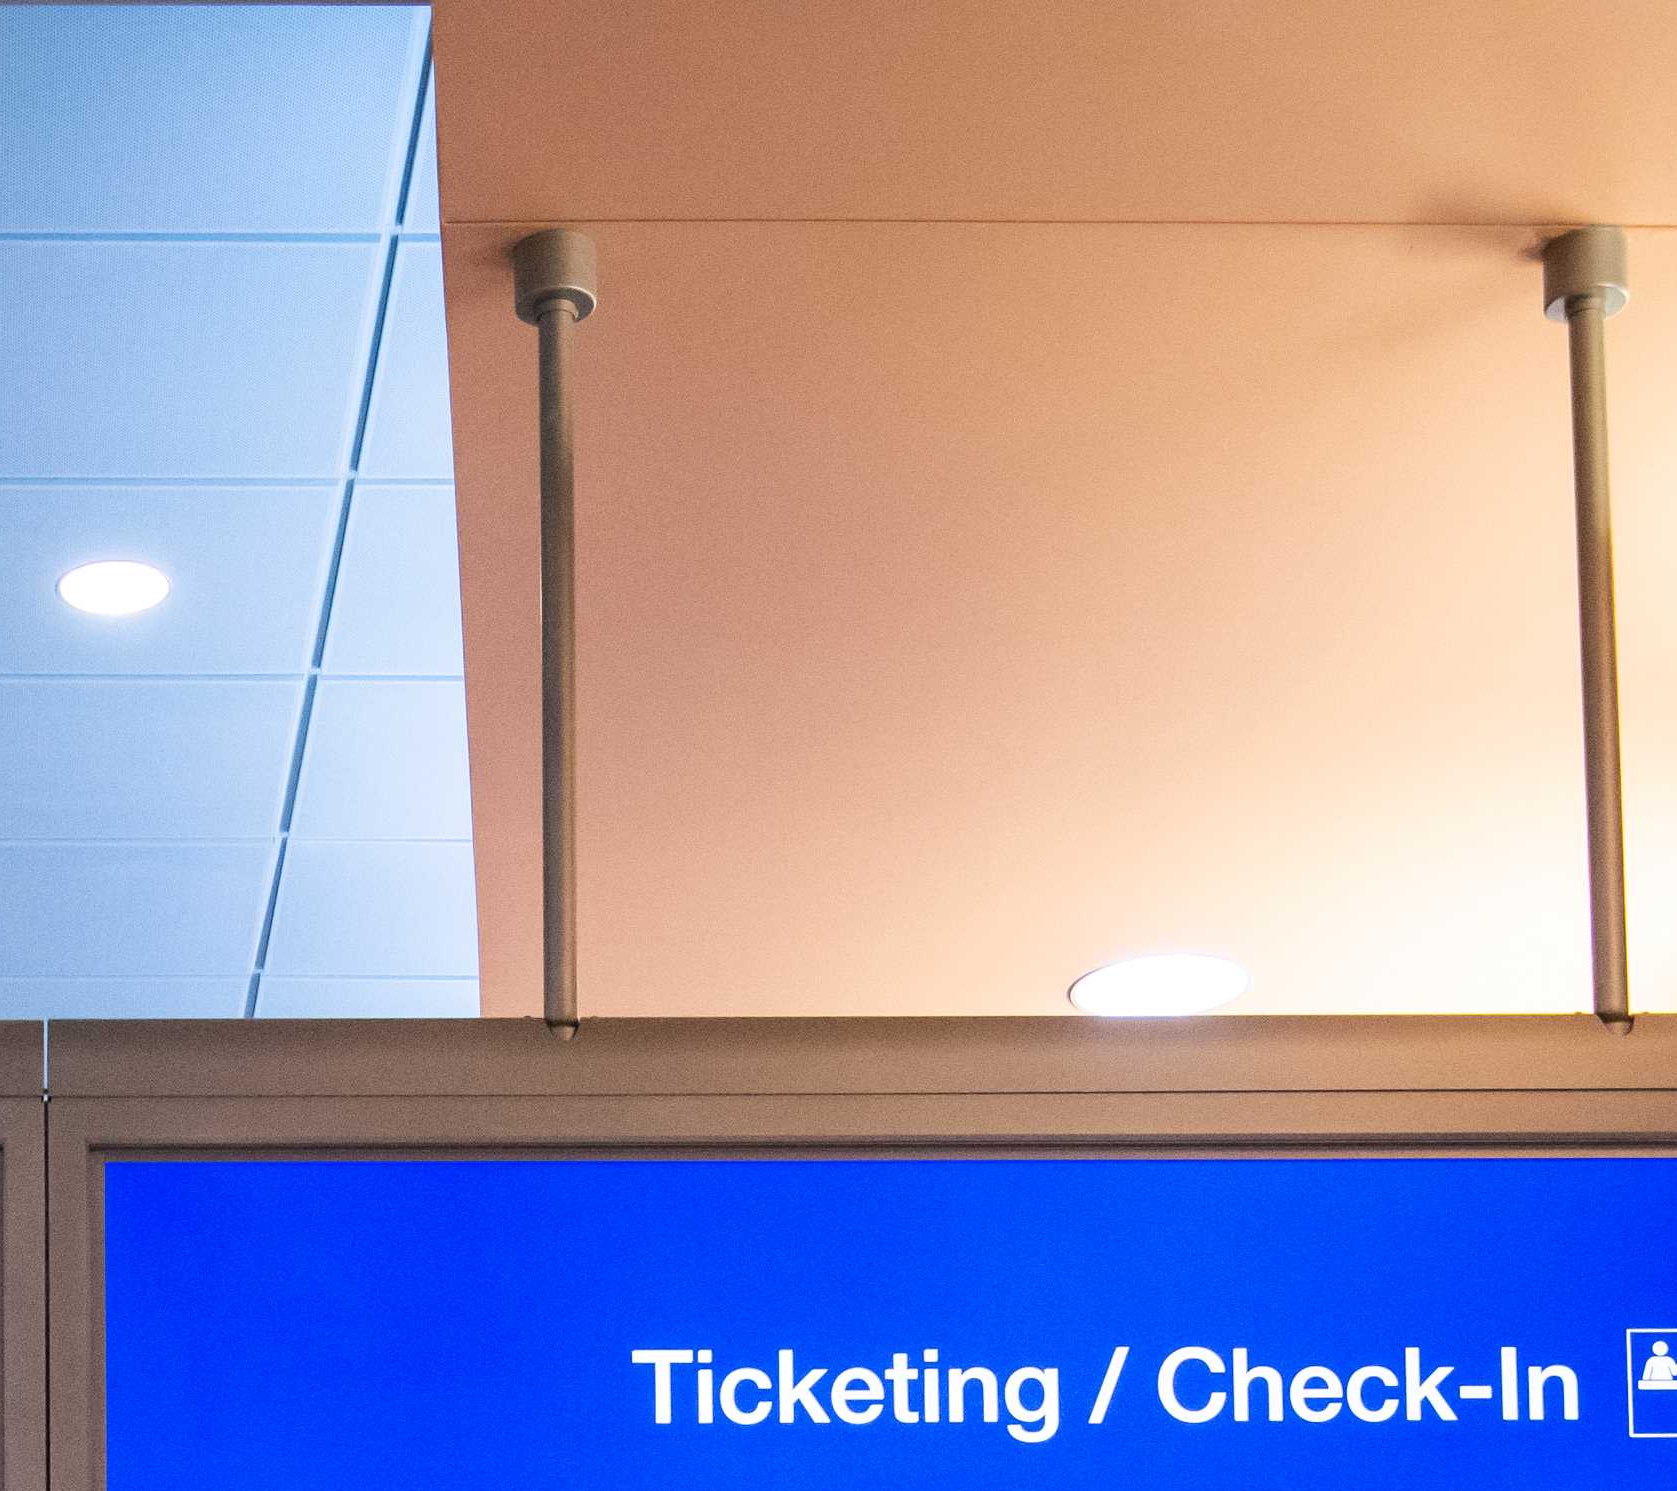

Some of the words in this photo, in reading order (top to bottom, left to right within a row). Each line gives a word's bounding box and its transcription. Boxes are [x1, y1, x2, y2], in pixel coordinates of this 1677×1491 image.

[631, 1348, 1060, 1443] Ticketing
[1088, 1346, 1130, 1425] /
[1157, 1346, 1579, 1424] Check-In
